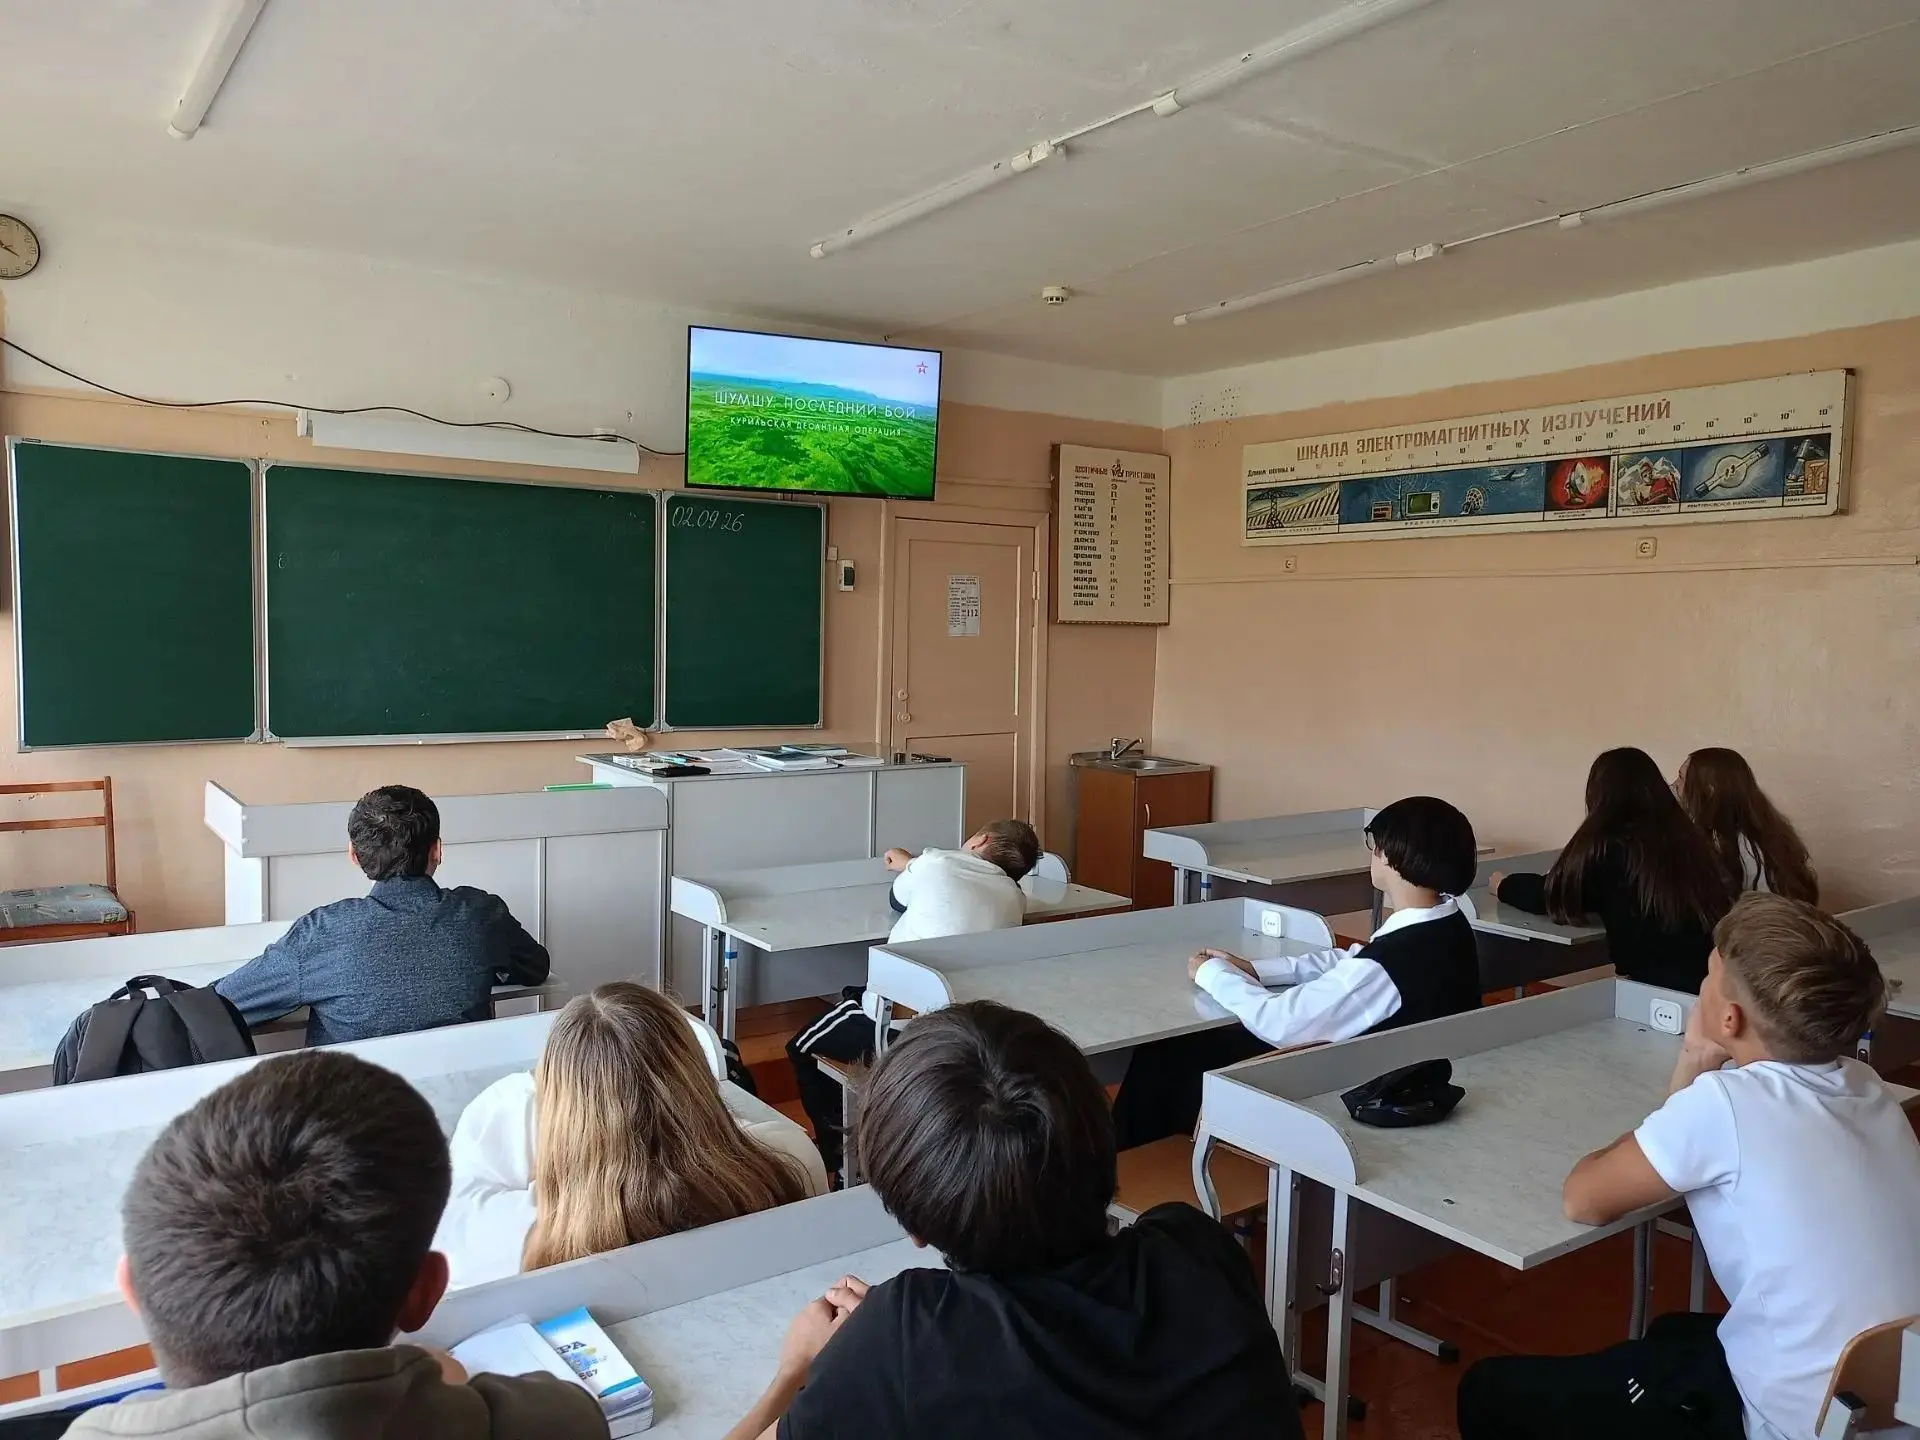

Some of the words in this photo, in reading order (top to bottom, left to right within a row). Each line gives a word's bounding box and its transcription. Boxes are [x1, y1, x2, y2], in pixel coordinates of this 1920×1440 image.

[784, 397, 878, 416] ПОСЛЕДНИЙ
[885, 406, 916, 419] БОЙ
[730, 416, 792, 429] КУРИЛЬСКАЯ
[796, 422, 850, 433] ДЕСАНТНАЯ
[854, 426, 901, 437] ОПЕРАЦИЯ
[1296, 441, 1349, 461] ШКАЛА
[1356, 418, 1530, 454] ЭЛЕКТРОМАГНИТНЫХ
[1541, 399, 1671, 433] ИЗЛУЧЕНИЙ
